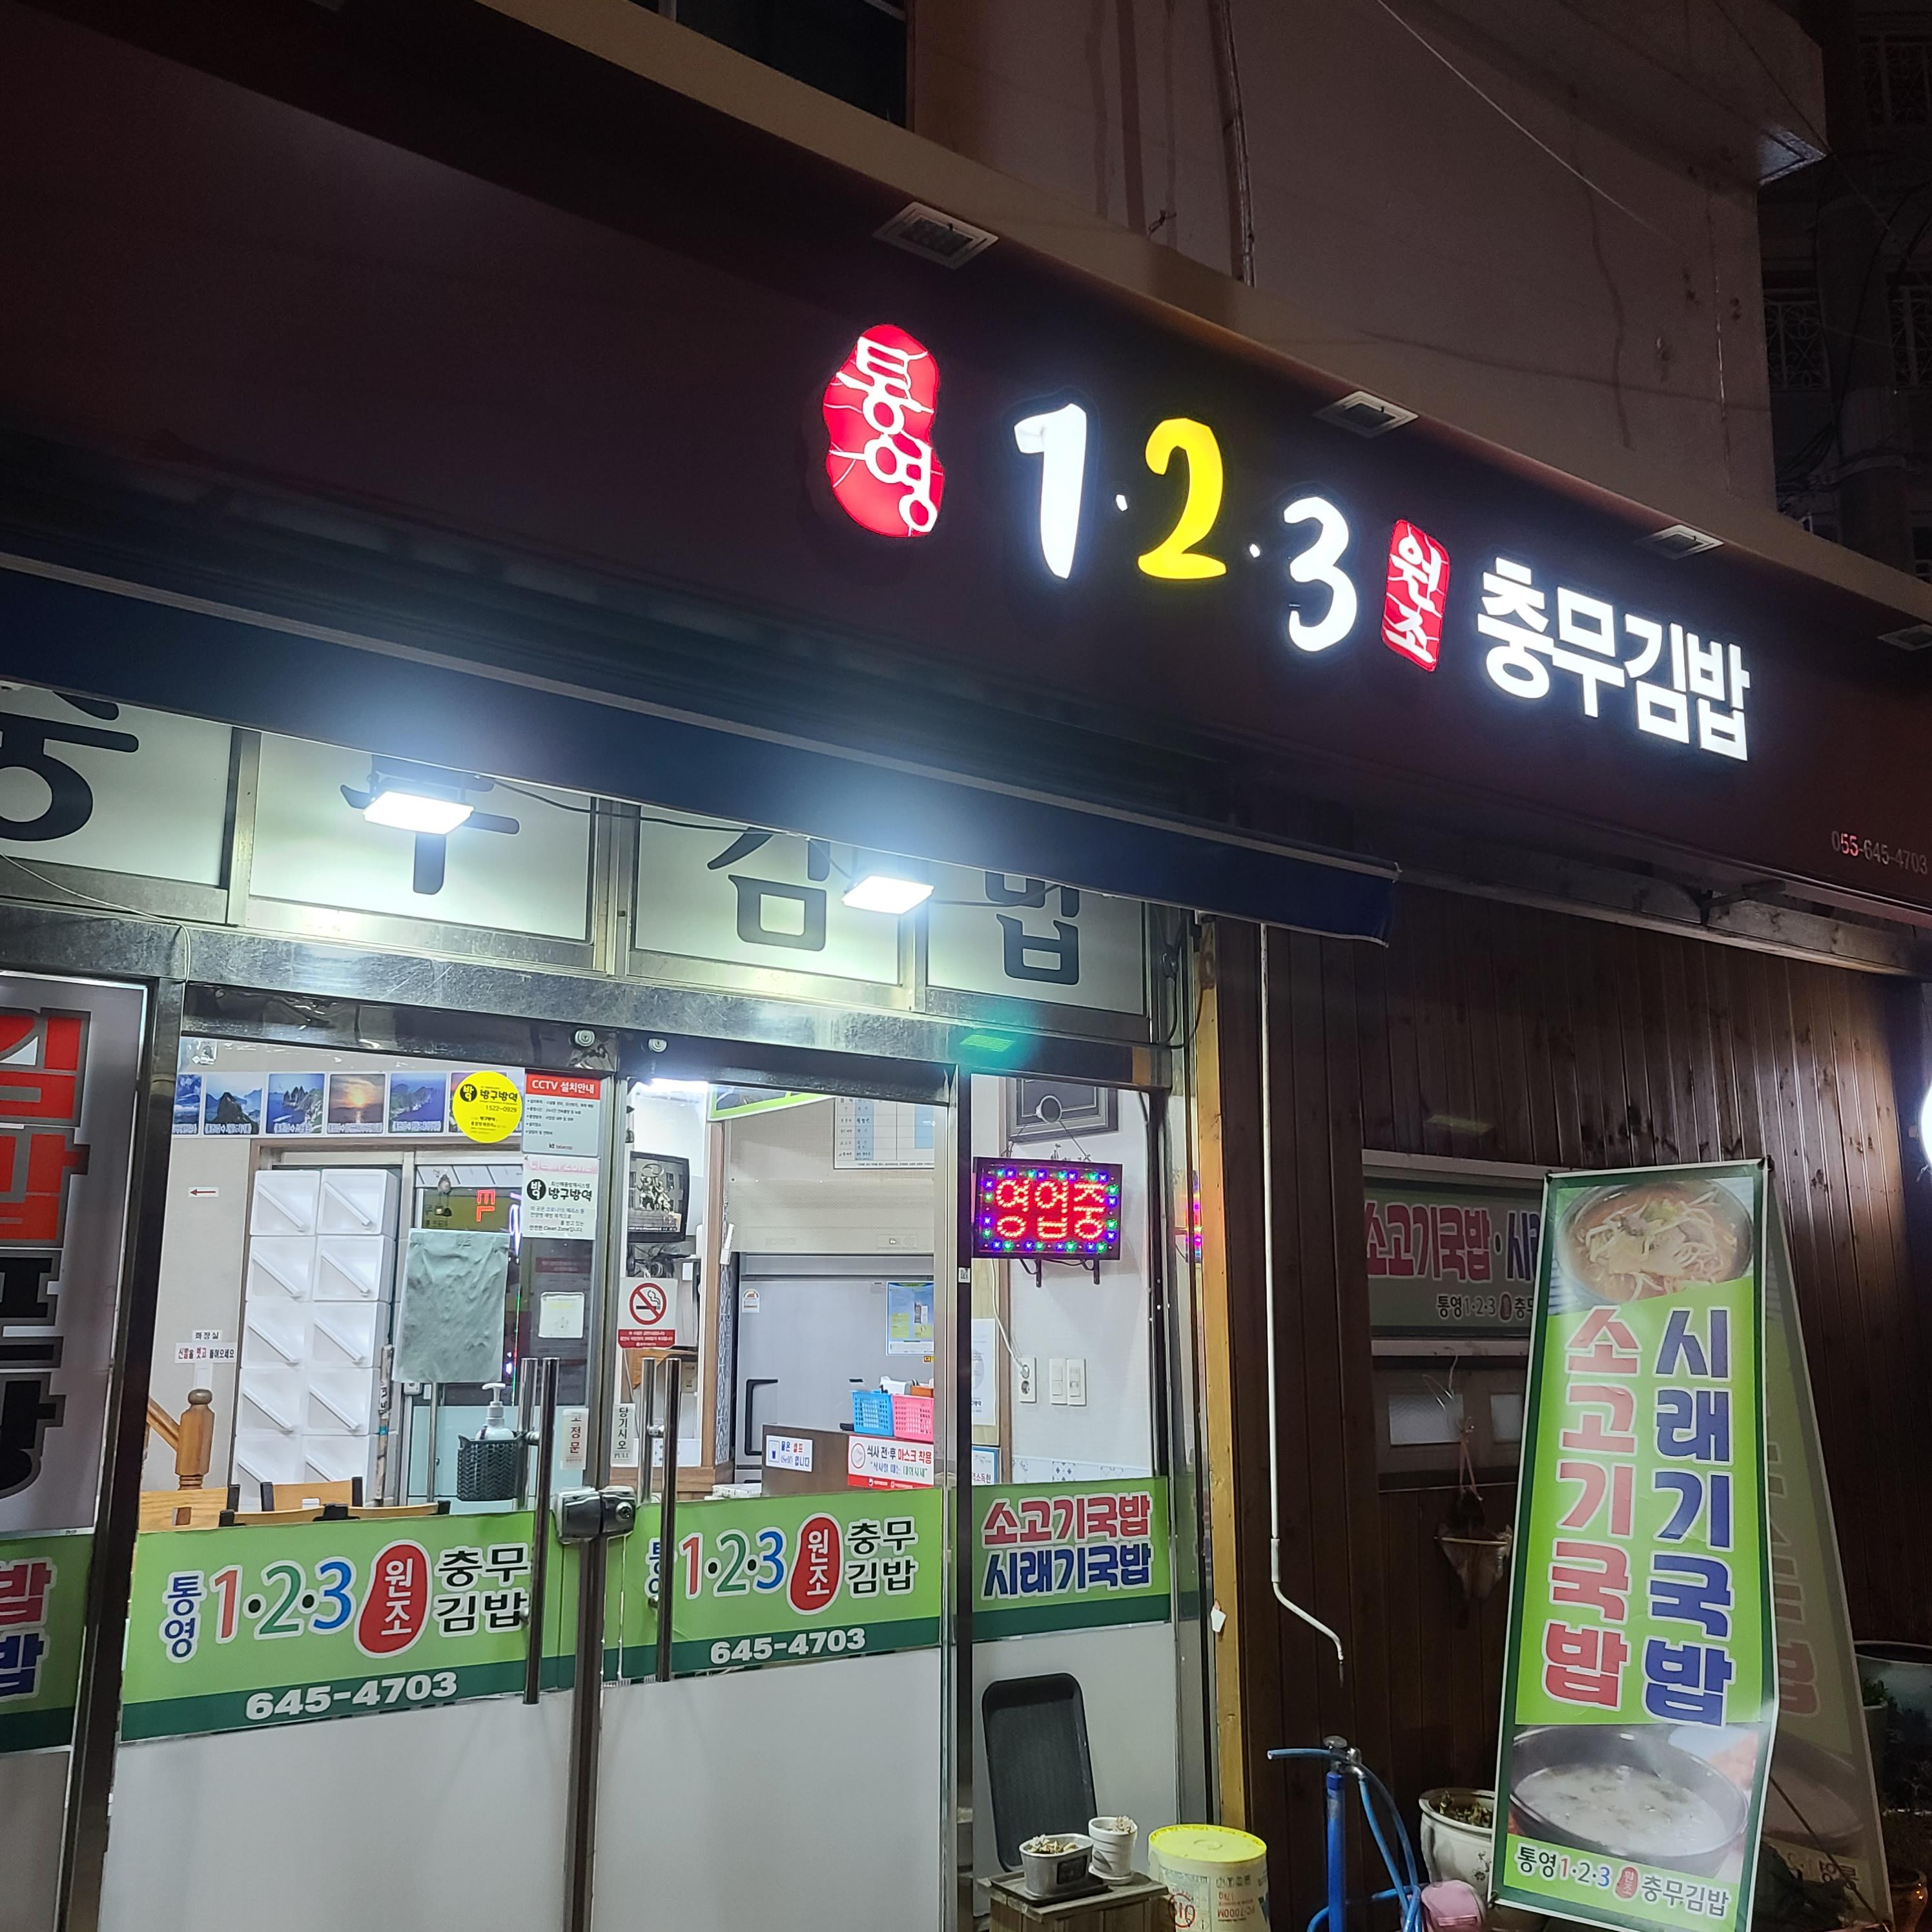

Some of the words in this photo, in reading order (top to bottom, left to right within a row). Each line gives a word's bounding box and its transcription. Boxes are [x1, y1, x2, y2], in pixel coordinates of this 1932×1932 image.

[829, 335, 937, 533] 통영
[1386, 533, 1442, 664] 원조
[1477, 557, 1751, 761] 충무김밥
[1831, 830, 1927, 875] 055-645-4703
[480, 1089, 518, 1102] 방구방역
[532, 1080, 558, 1089] CCTV
[560, 1083, 595, 1094] 설치안내
[486, 1105, 517, 1113] 1522-0929
[548, 1187, 593, 1202] 방구방역
[995, 1180, 1107, 1239] 영업중
[1364, 1202, 1491, 1280] 소고기국밥
[1437, 1295, 1462, 1318] 통영
[178, 1347, 194, 1359] 신발을
[196, 1347, 207, 1359] 벗고
[195, 1331, 219, 1340] 화장실
[617, 1407, 629, 1450] 당기시오
[867, 1444, 879, 1459] 식사
[898, 1448, 917, 1463] 마스크
[918, 1450, 932, 1464] 착용
[984, 1495, 1150, 1545] 소고기국밥
[1545, 1309, 1641, 1709] 소고기국밥
[1646, 1309, 1732, 1727] 시래기국밥
[847, 1519, 917, 1555] 충무
[438, 1547, 529, 1587] 충무
[807, 1530, 832, 1596] 원조
[847, 1559, 916, 1594] 김밥
[983, 1543, 1151, 1597] 시래기국밥
[165, 1576, 201, 1658] 통영
[381, 1559, 414, 1636] 원조
[437, 1592, 528, 1632] 김밥
[710, 1629, 866, 1664] 645-4703
[246, 1672, 457, 1720] 645-4703
[1517, 1846, 1557, 1878] 통영
[1641, 1875, 1730, 1917] 충무김밥
